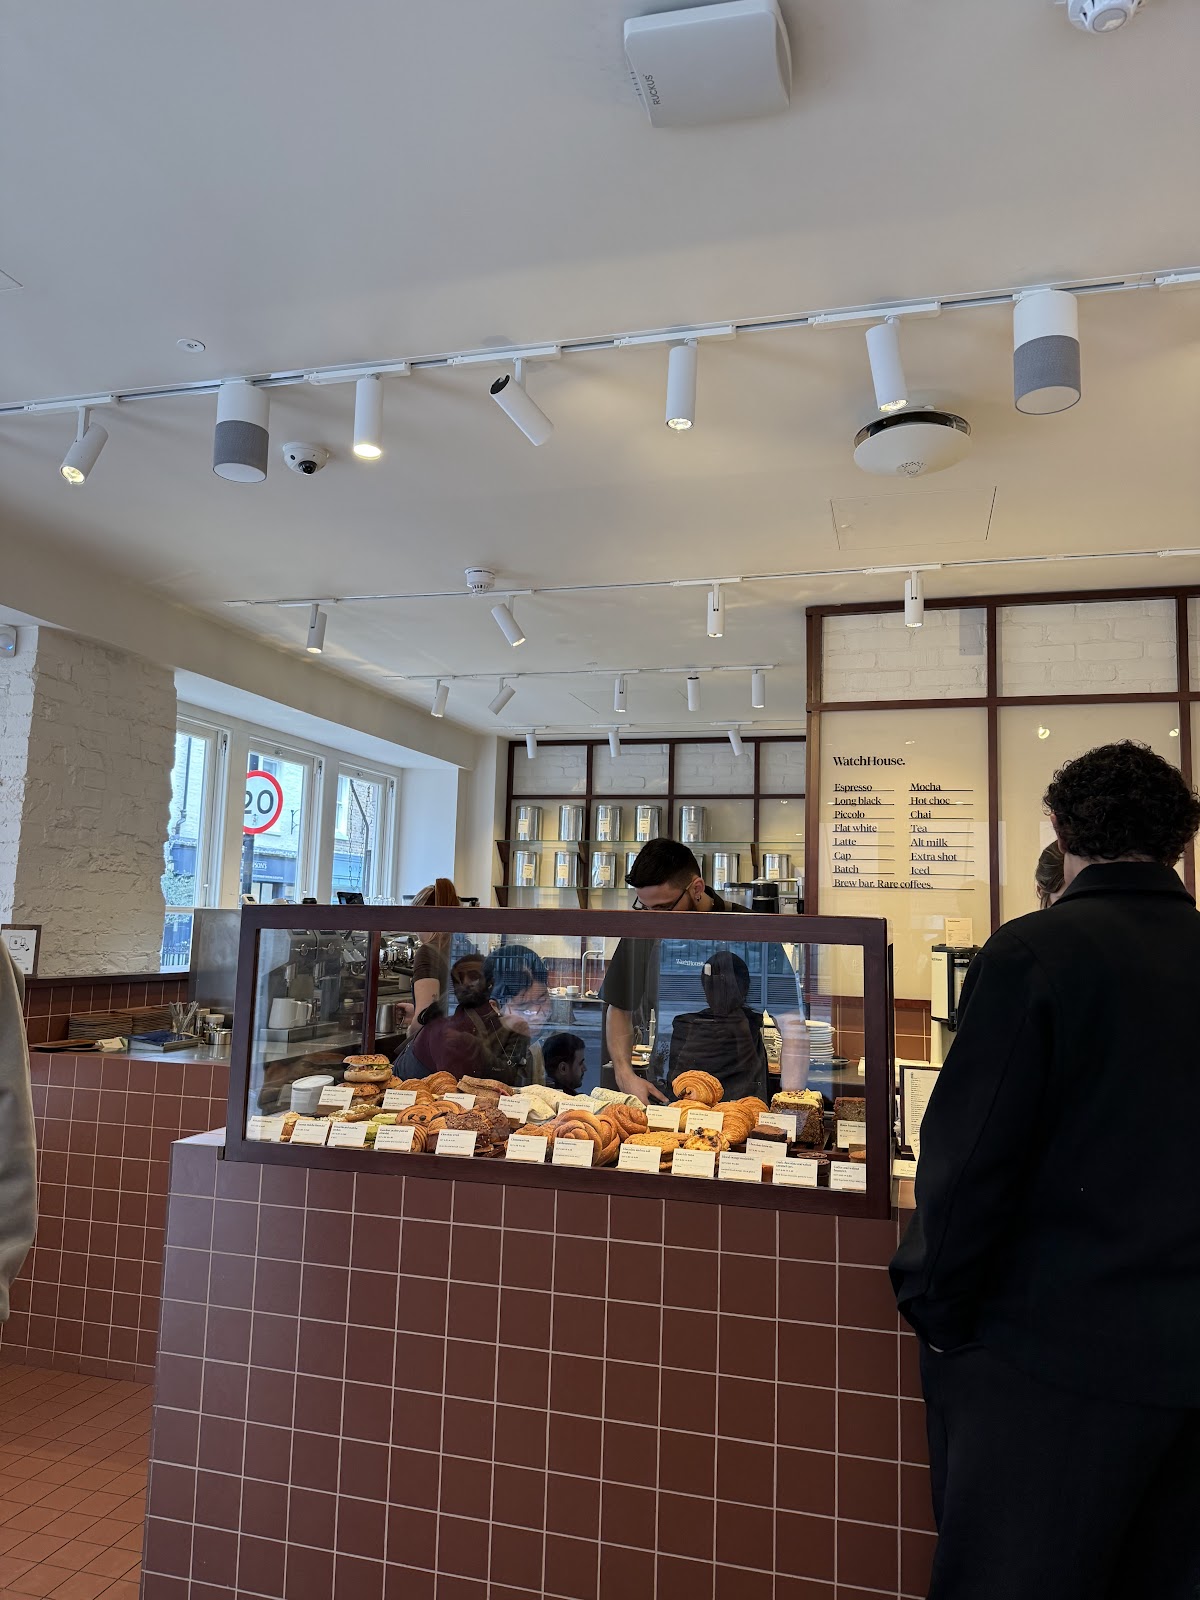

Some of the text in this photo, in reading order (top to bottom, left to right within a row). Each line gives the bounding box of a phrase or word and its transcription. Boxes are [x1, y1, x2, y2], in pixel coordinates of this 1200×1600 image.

[645, 74, 661, 105] RUCKUS
[833, 755, 906, 766] WatchHouse.
[834, 783, 873, 793] Espresso
[911, 782, 942, 791] Mocha
[835, 796, 882, 807] Long black
[910, 796, 951, 805] Hot choc
[834, 810, 866, 819] Piccolo
[910, 810, 932, 819] Chai
[834, 823, 878, 833] Flat white
[910, 824, 928, 833] Tea
[834, 837, 857, 847] Latte
[910, 838, 949, 848] Alt milk
[834, 851, 852, 862] Cap
[911, 852, 958, 862] Extra shot
[834, 865, 859, 874] Batch
[911, 866, 930, 875] Iced
[834, 879, 857, 888] Brew
[877, 879, 898, 889] Rare
[899, 880, 934, 890] coffees.
